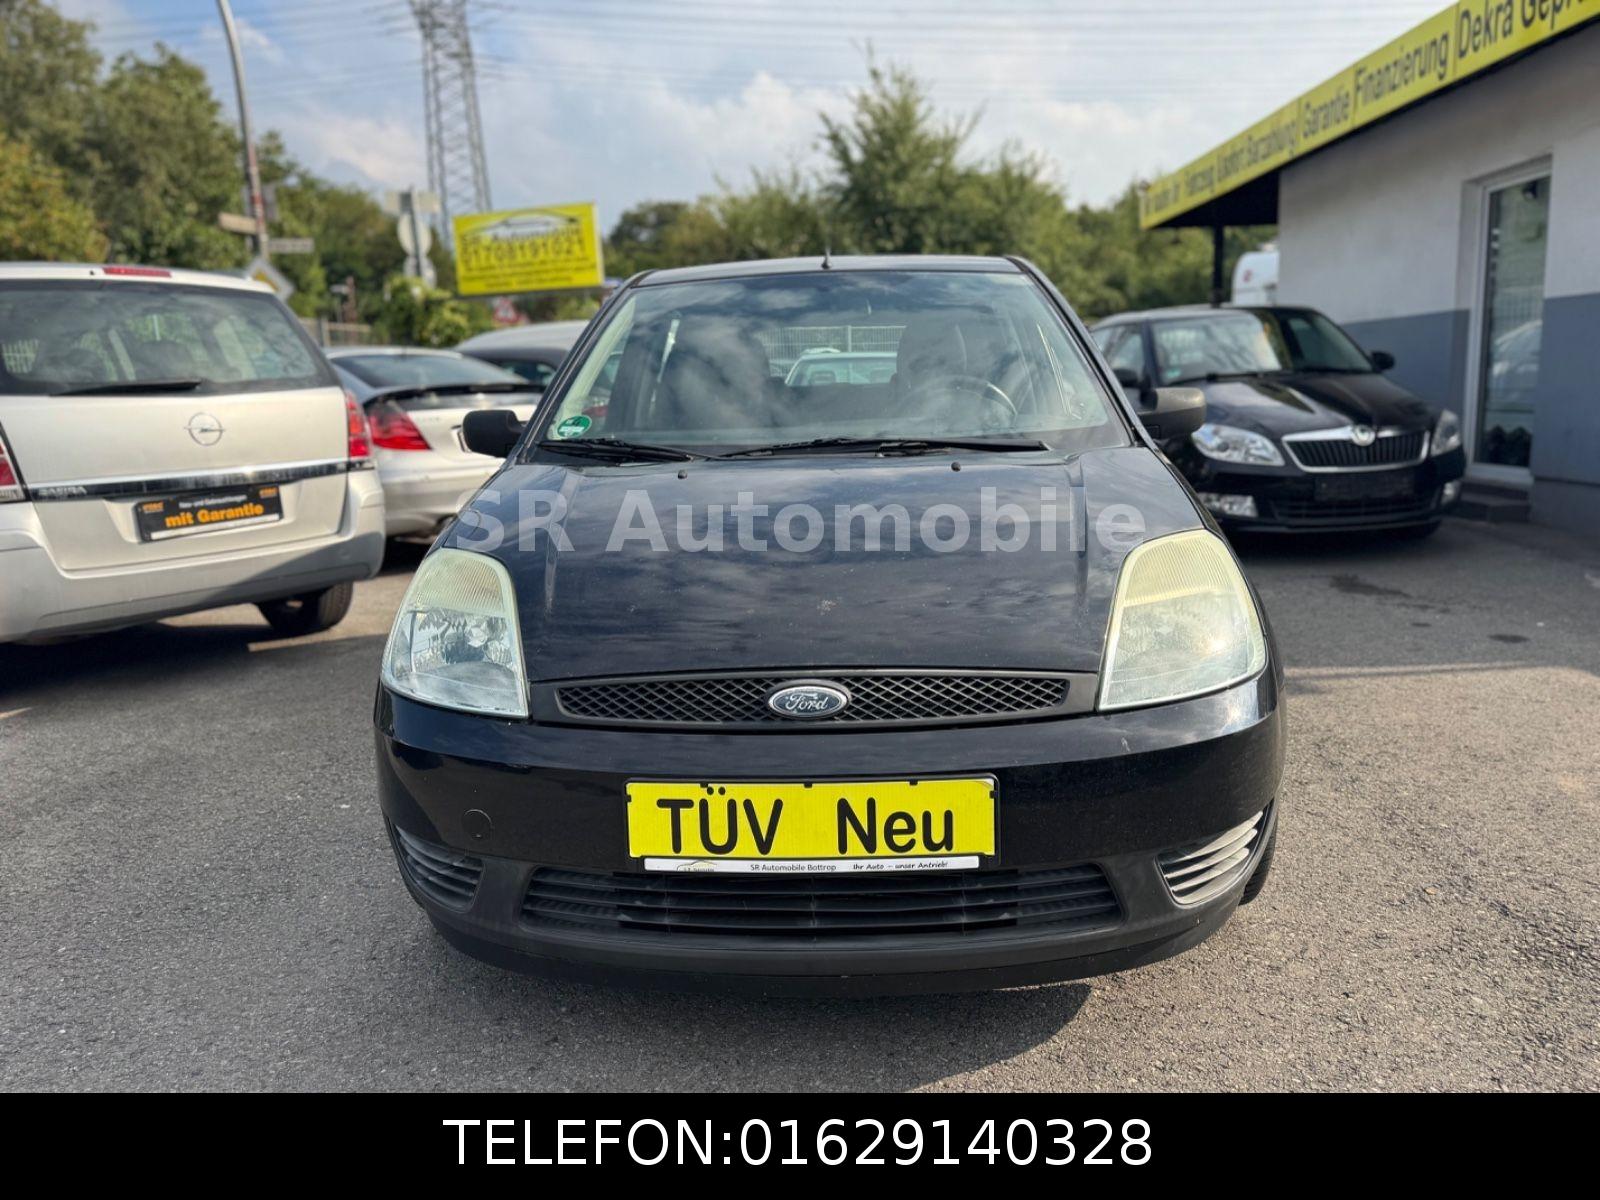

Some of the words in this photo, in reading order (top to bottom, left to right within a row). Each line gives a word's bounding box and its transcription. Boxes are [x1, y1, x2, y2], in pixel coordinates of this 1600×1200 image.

[1459, 0, 1514, 58] Dekra
[1354, 31, 1450, 107] Finanzierung
[1302, 84, 1351, 139] Garantie
[165, 511, 194, 528] mit
[197, 503, 265, 523] Garantie
[785, 692, 829, 710] Ford
[656, 786, 784, 855] TÜV
[836, 797, 954, 854] Neu
[762, 863, 805, 872] Automobile
[807, 864, 837, 873] Bottrop
[853, 862, 864, 870] Ihr
